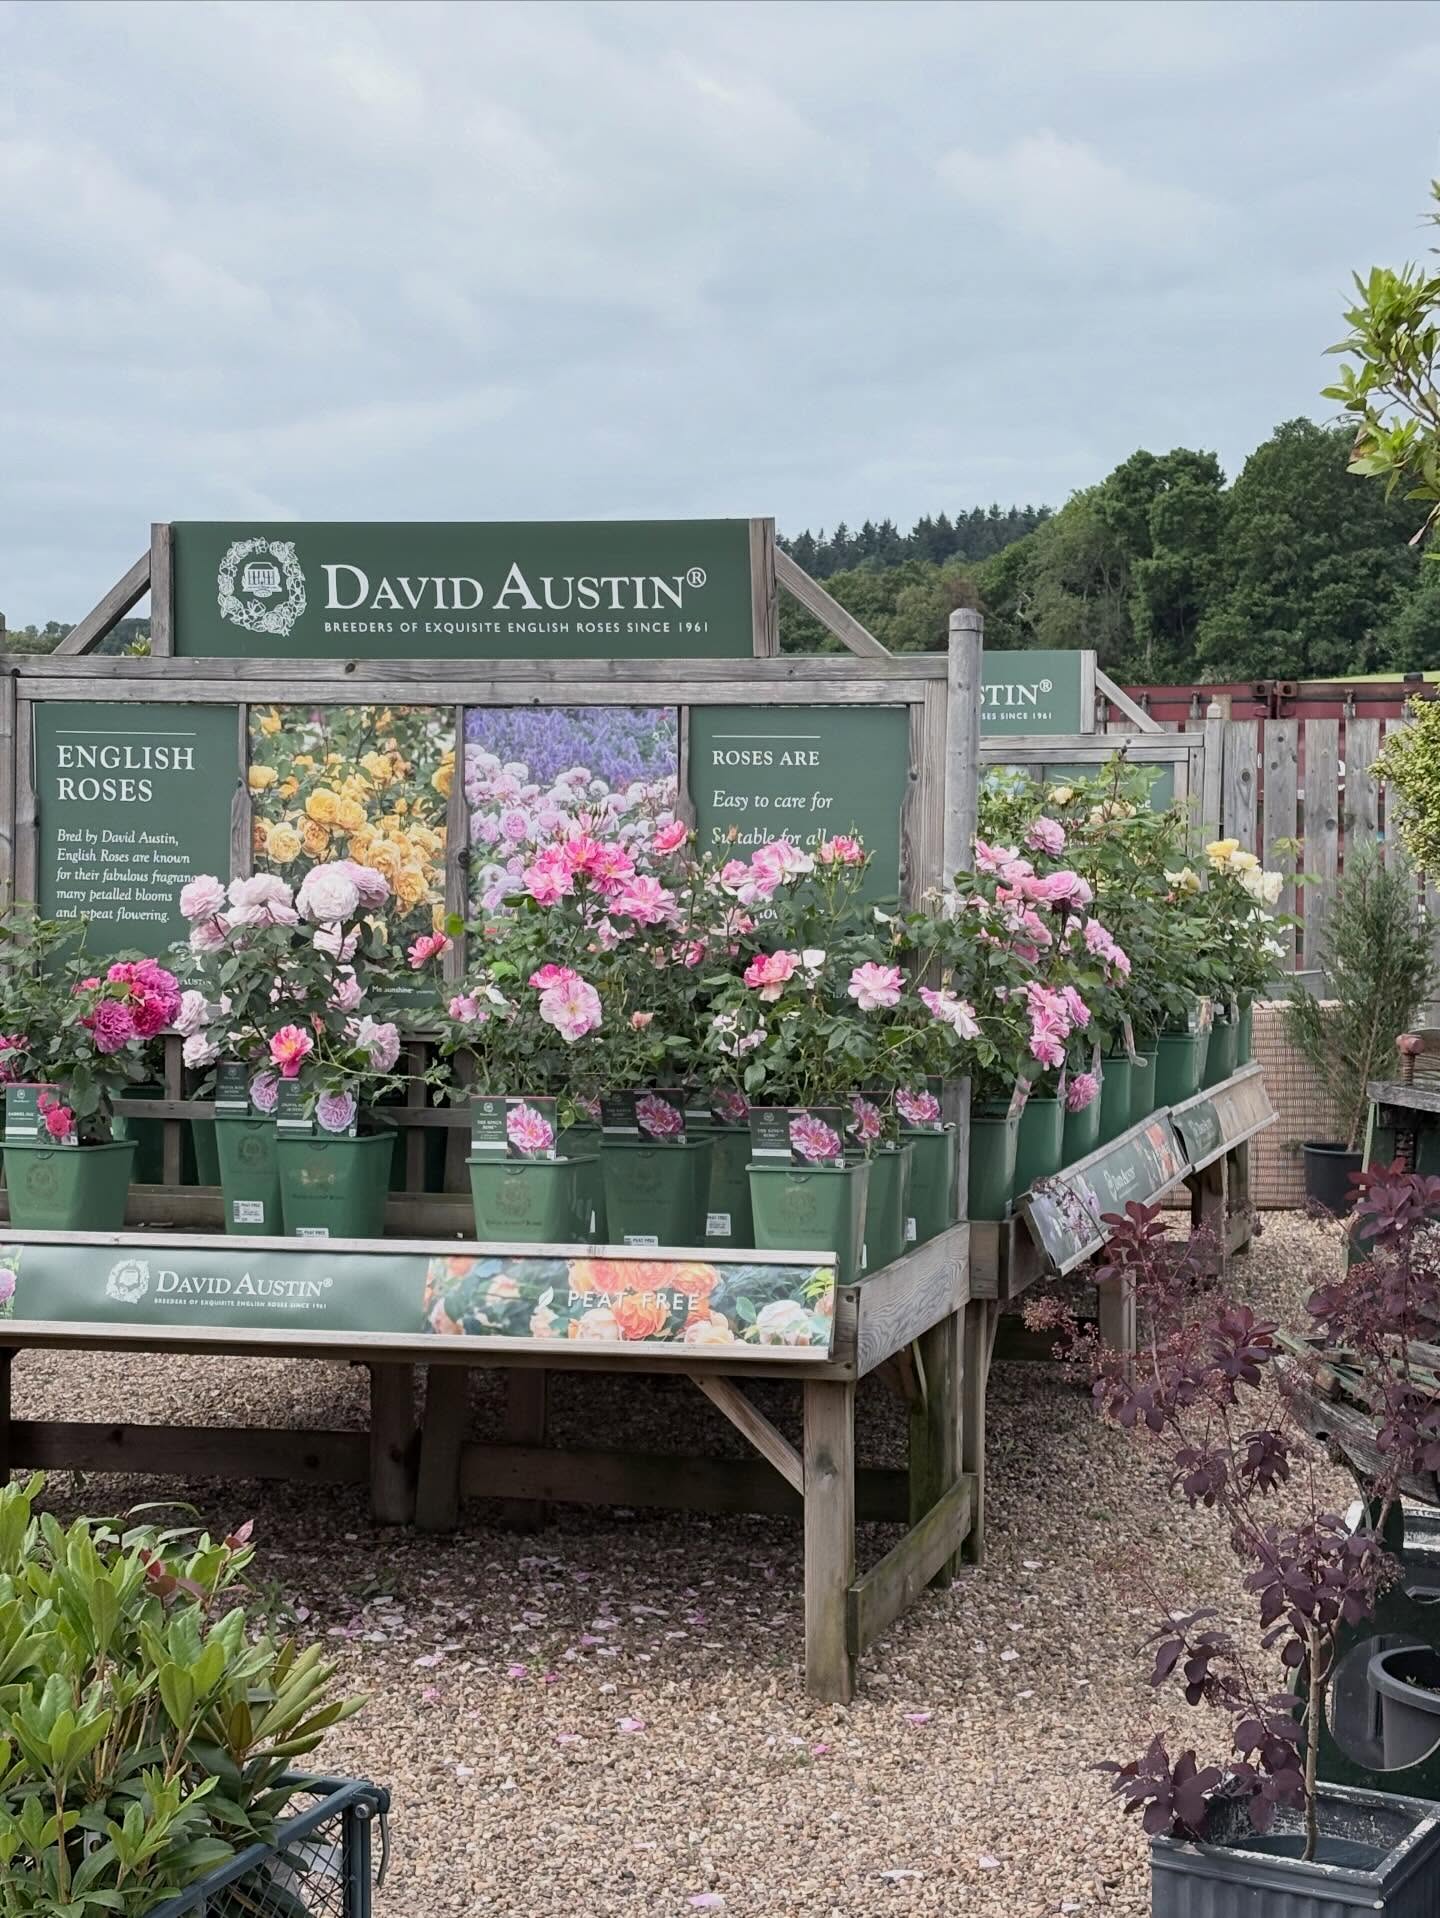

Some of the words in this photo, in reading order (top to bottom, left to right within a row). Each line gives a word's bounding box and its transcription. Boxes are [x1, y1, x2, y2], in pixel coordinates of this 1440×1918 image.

[320, 564, 484, 610] DAVID
[324, 622, 393, 633] BREEDERS
[399, 622, 418, 633] OF
[425, 622, 501, 634] EXQUISITE
[507, 622, 569, 633] ENGLISH
[576, 622, 620, 633] ROSES
[626, 622, 670, 633] SINCE
[679, 622, 708, 633] 1961
[1000, 712, 1028, 720] SINCE
[1032, 712, 1053, 720] 1961
[56, 744, 196, 770] ENGLISH
[712, 750, 773, 766] ROSES
[779, 750, 820, 766] ARE
[56, 777, 153, 802] ROSES
[712, 790, 749, 811] Easy
[754, 796, 770, 808] to
[774, 797, 806, 809] care
[810, 792, 834, 812] for
[57, 828, 82, 842] Bred
[85, 828, 98, 845] by
[102, 830, 136, 844] David
[139, 831, 179, 847] Austin,
[711, 826, 775, 845] Sutable
[778, 827, 801, 845] for
[806, 827, 827, 845] all
[57, 848, 97, 864] English
[100, 849, 130, 863] Roses
[133, 854, 150, 863] are
[153, 849, 190, 864] known
[56, 866, 72, 882] for
[75, 868, 100, 882] their
[103, 867, 149, 884] fabulous
[56, 889, 87, 902] many
[90, 887, 132, 903] petalled
[135, 887, 173, 902] blooms
[56, 905, 77, 918] and
[115, 906, 170, 924] flowering.
[156, 1270, 231, 1294] DAVID
[567, 1290, 628, 1308] PEAT
[642, 1292, 700, 1311] FREE
